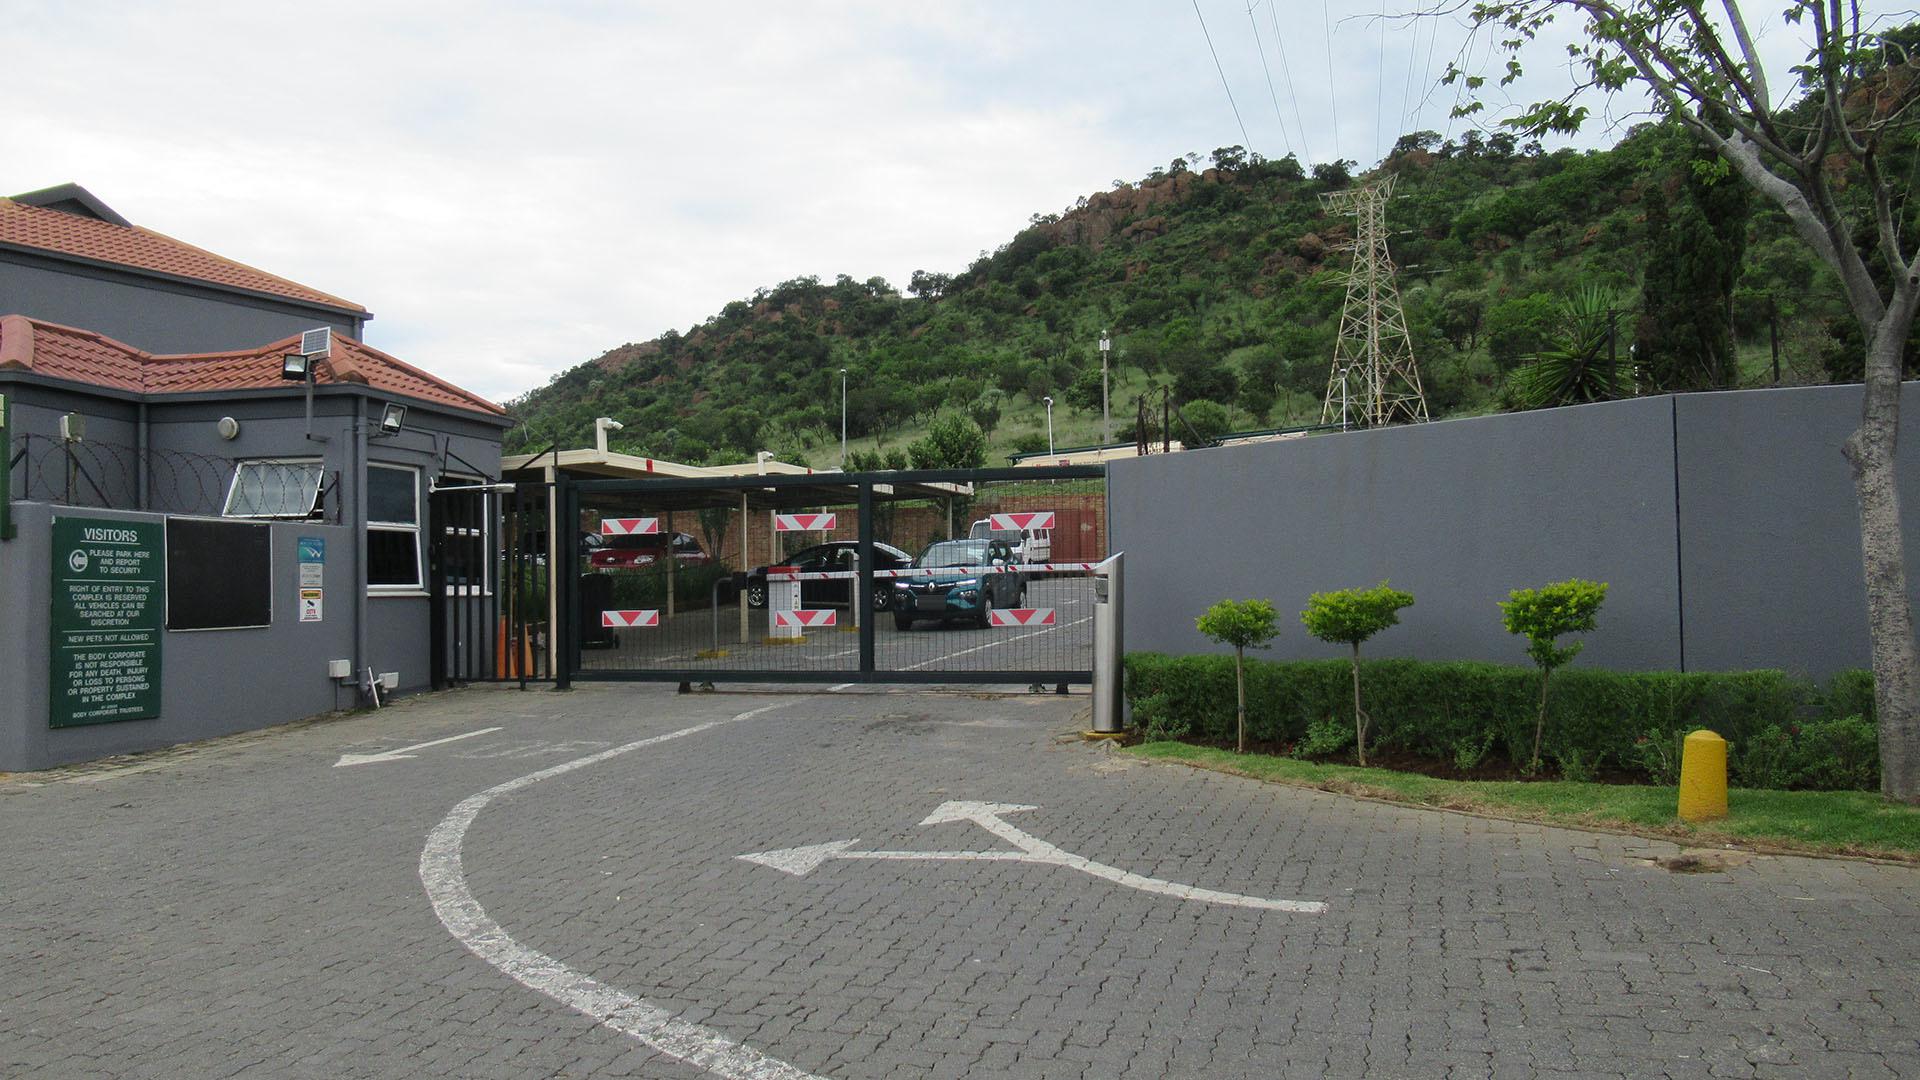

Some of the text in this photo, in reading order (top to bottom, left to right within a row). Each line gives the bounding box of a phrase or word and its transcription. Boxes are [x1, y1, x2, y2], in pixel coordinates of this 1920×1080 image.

[84, 528, 137, 542] VISITORS
[109, 651, 146, 659] CORPORATE
[100, 659, 143, 668] RESPONSIBLE
[80, 686, 113, 694] PROPERTY
[116, 683, 149, 692] SUSTAINED
[106, 692, 136, 700] COMPLEX
